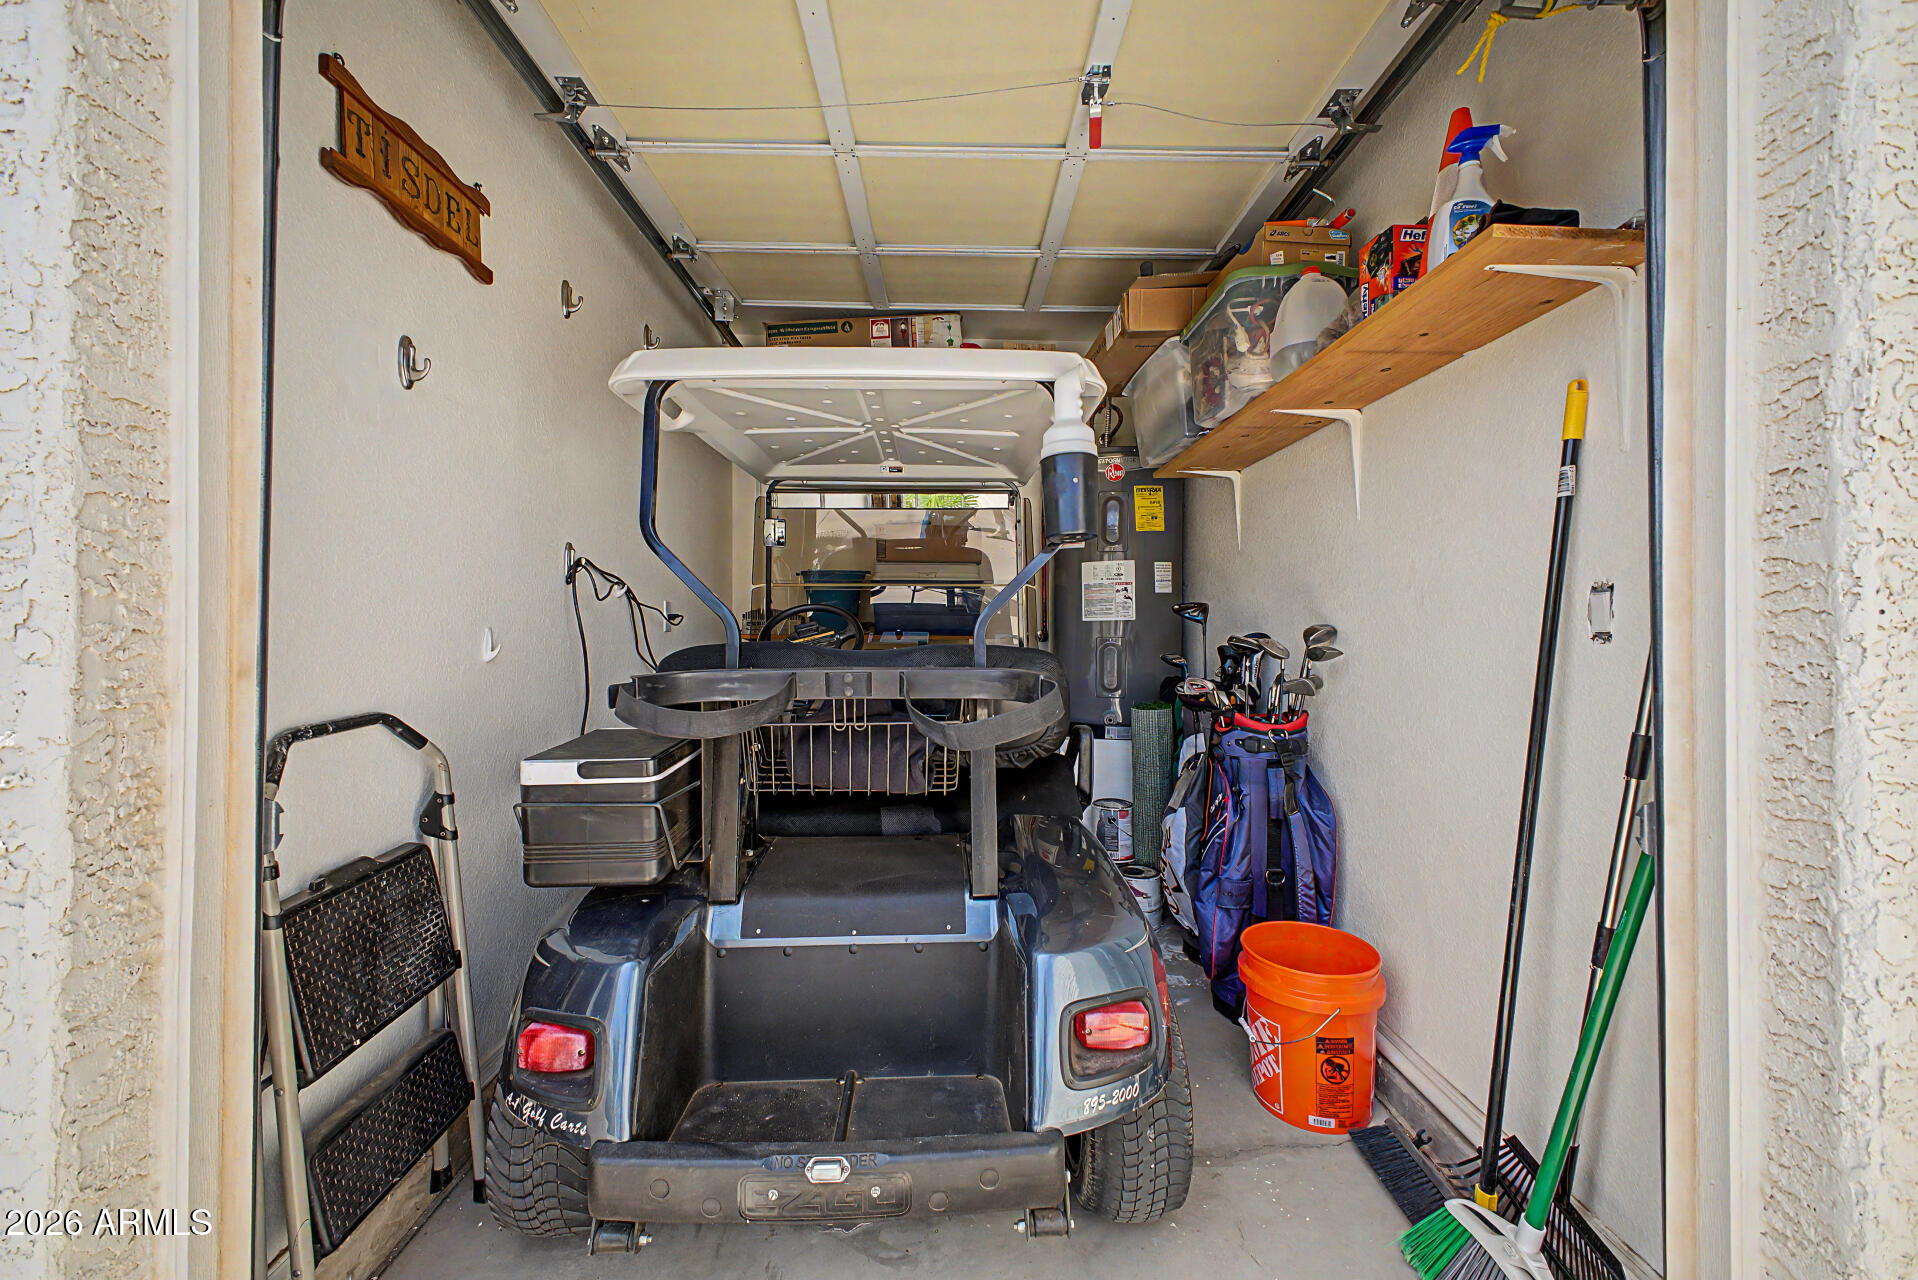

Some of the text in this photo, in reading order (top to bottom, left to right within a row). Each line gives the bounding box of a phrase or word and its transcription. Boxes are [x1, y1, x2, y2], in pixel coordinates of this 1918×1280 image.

[1402, 229, 1427, 241] Hef
[1083, 1082, 1140, 1116] 895-2000
[550, 1112, 588, 1136] Carts
[774, 1155, 794, 1169] NO
[850, 1154, 878, 1169] DER
